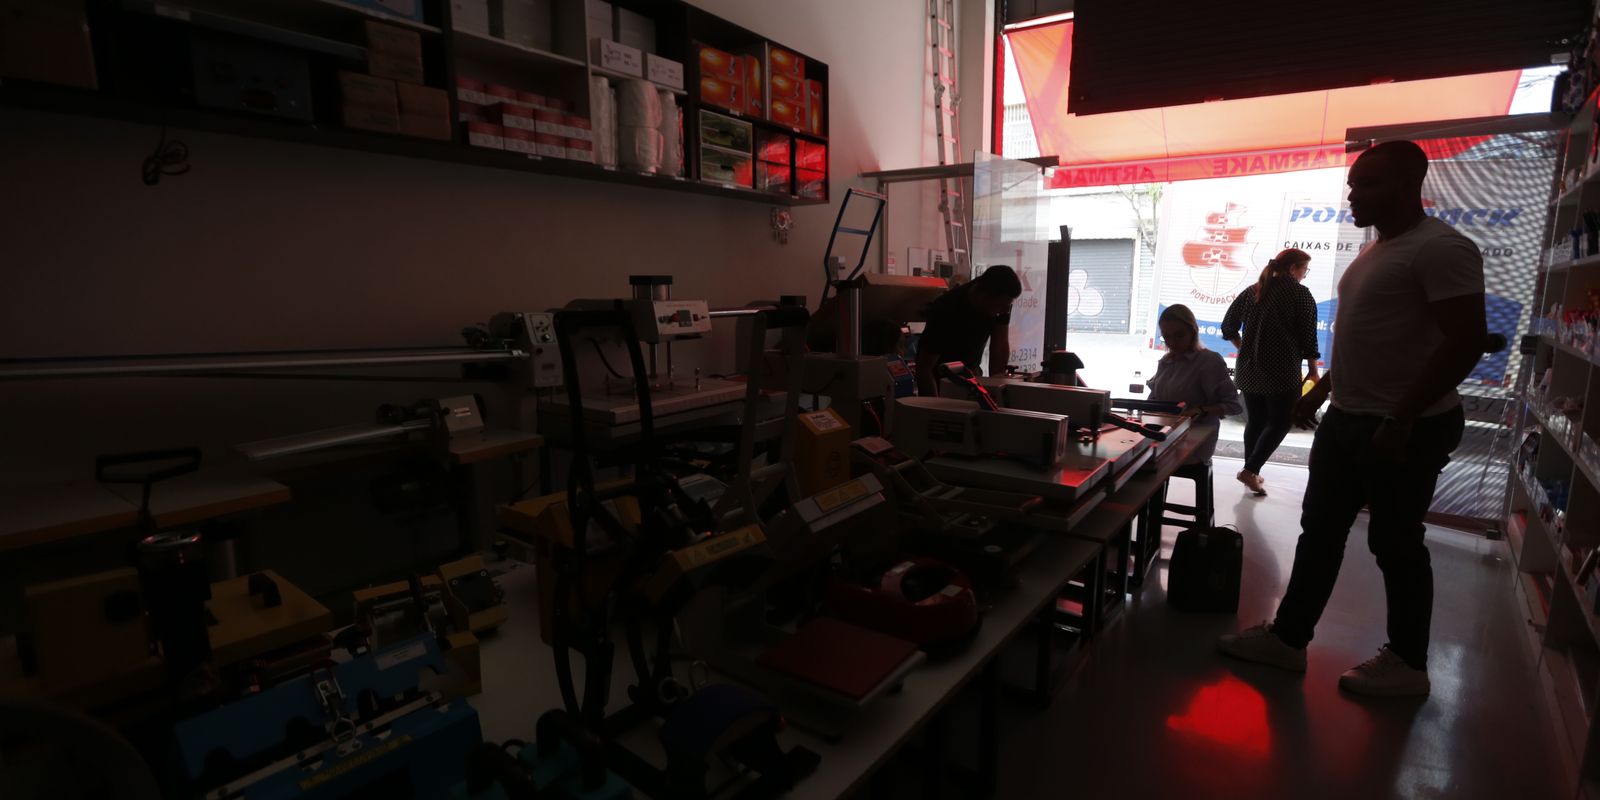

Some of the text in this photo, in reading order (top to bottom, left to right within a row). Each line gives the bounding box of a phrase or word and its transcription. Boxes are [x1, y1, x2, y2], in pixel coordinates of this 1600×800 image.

[1283, 240, 1331, 251] CAIXAS
[1336, 242, 1353, 252] DE
[1009, 348, 1038, 362] 8-2314
